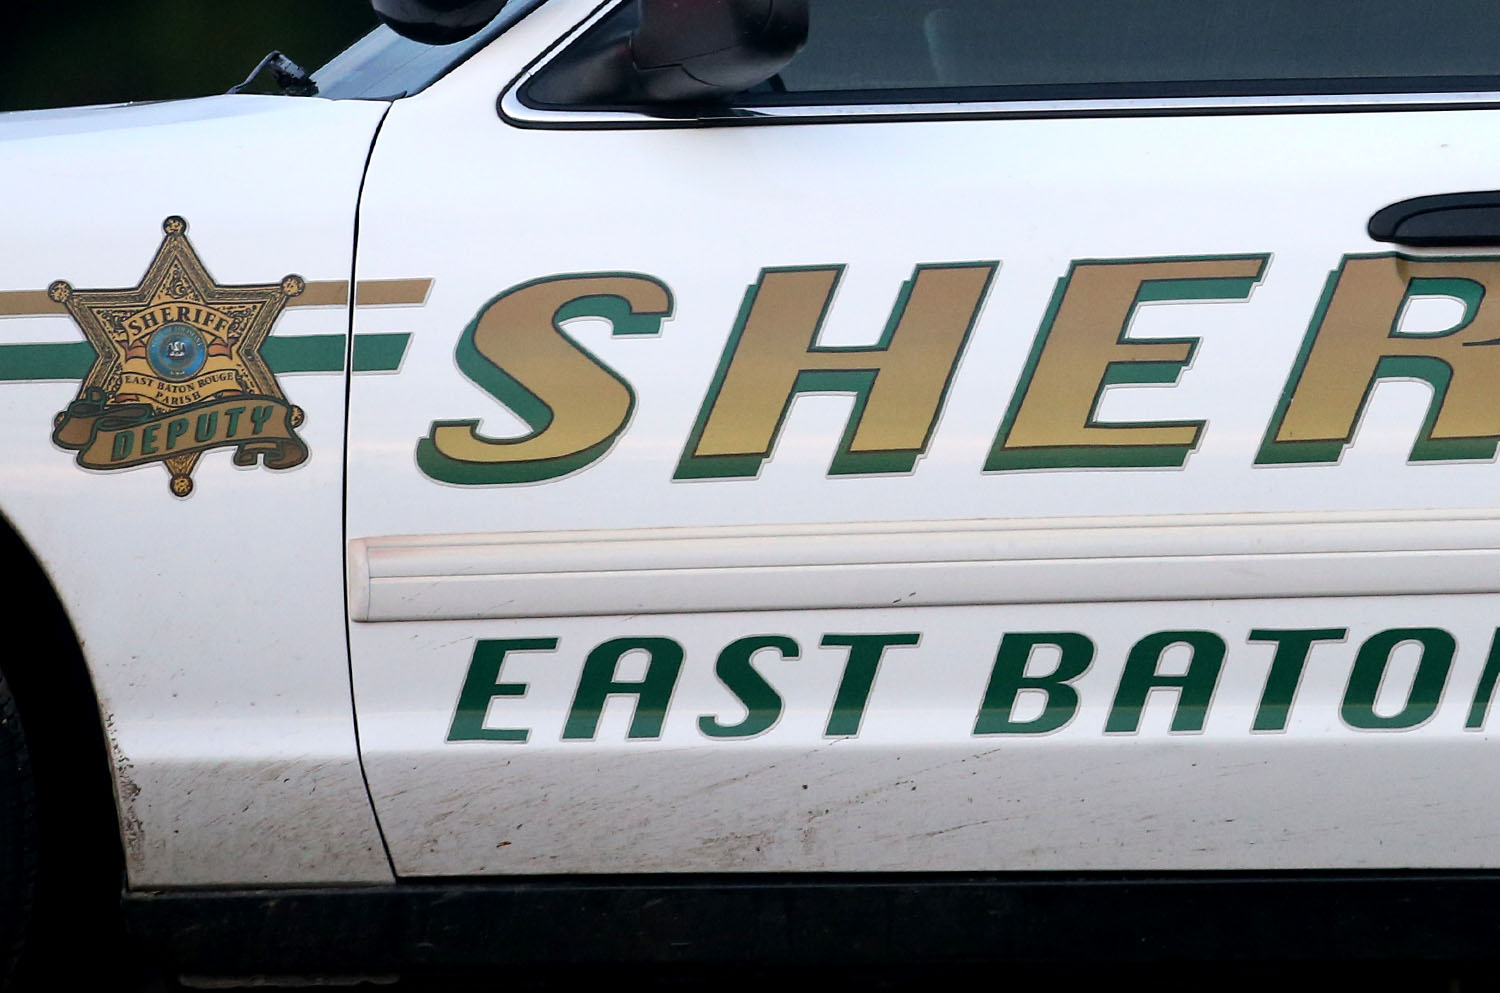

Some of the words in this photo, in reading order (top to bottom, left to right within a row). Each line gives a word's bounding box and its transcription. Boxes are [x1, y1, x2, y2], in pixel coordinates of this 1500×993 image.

[128, 306, 229, 336] SHERIFF
[125, 375, 154, 387] EAST
[156, 383, 195, 393] BATON
[197, 372, 234, 388] ROUGE
[155, 392, 201, 405] PARISH
[111, 405, 275, 461] DEPUTY
[446, 632, 920, 742] EAST
